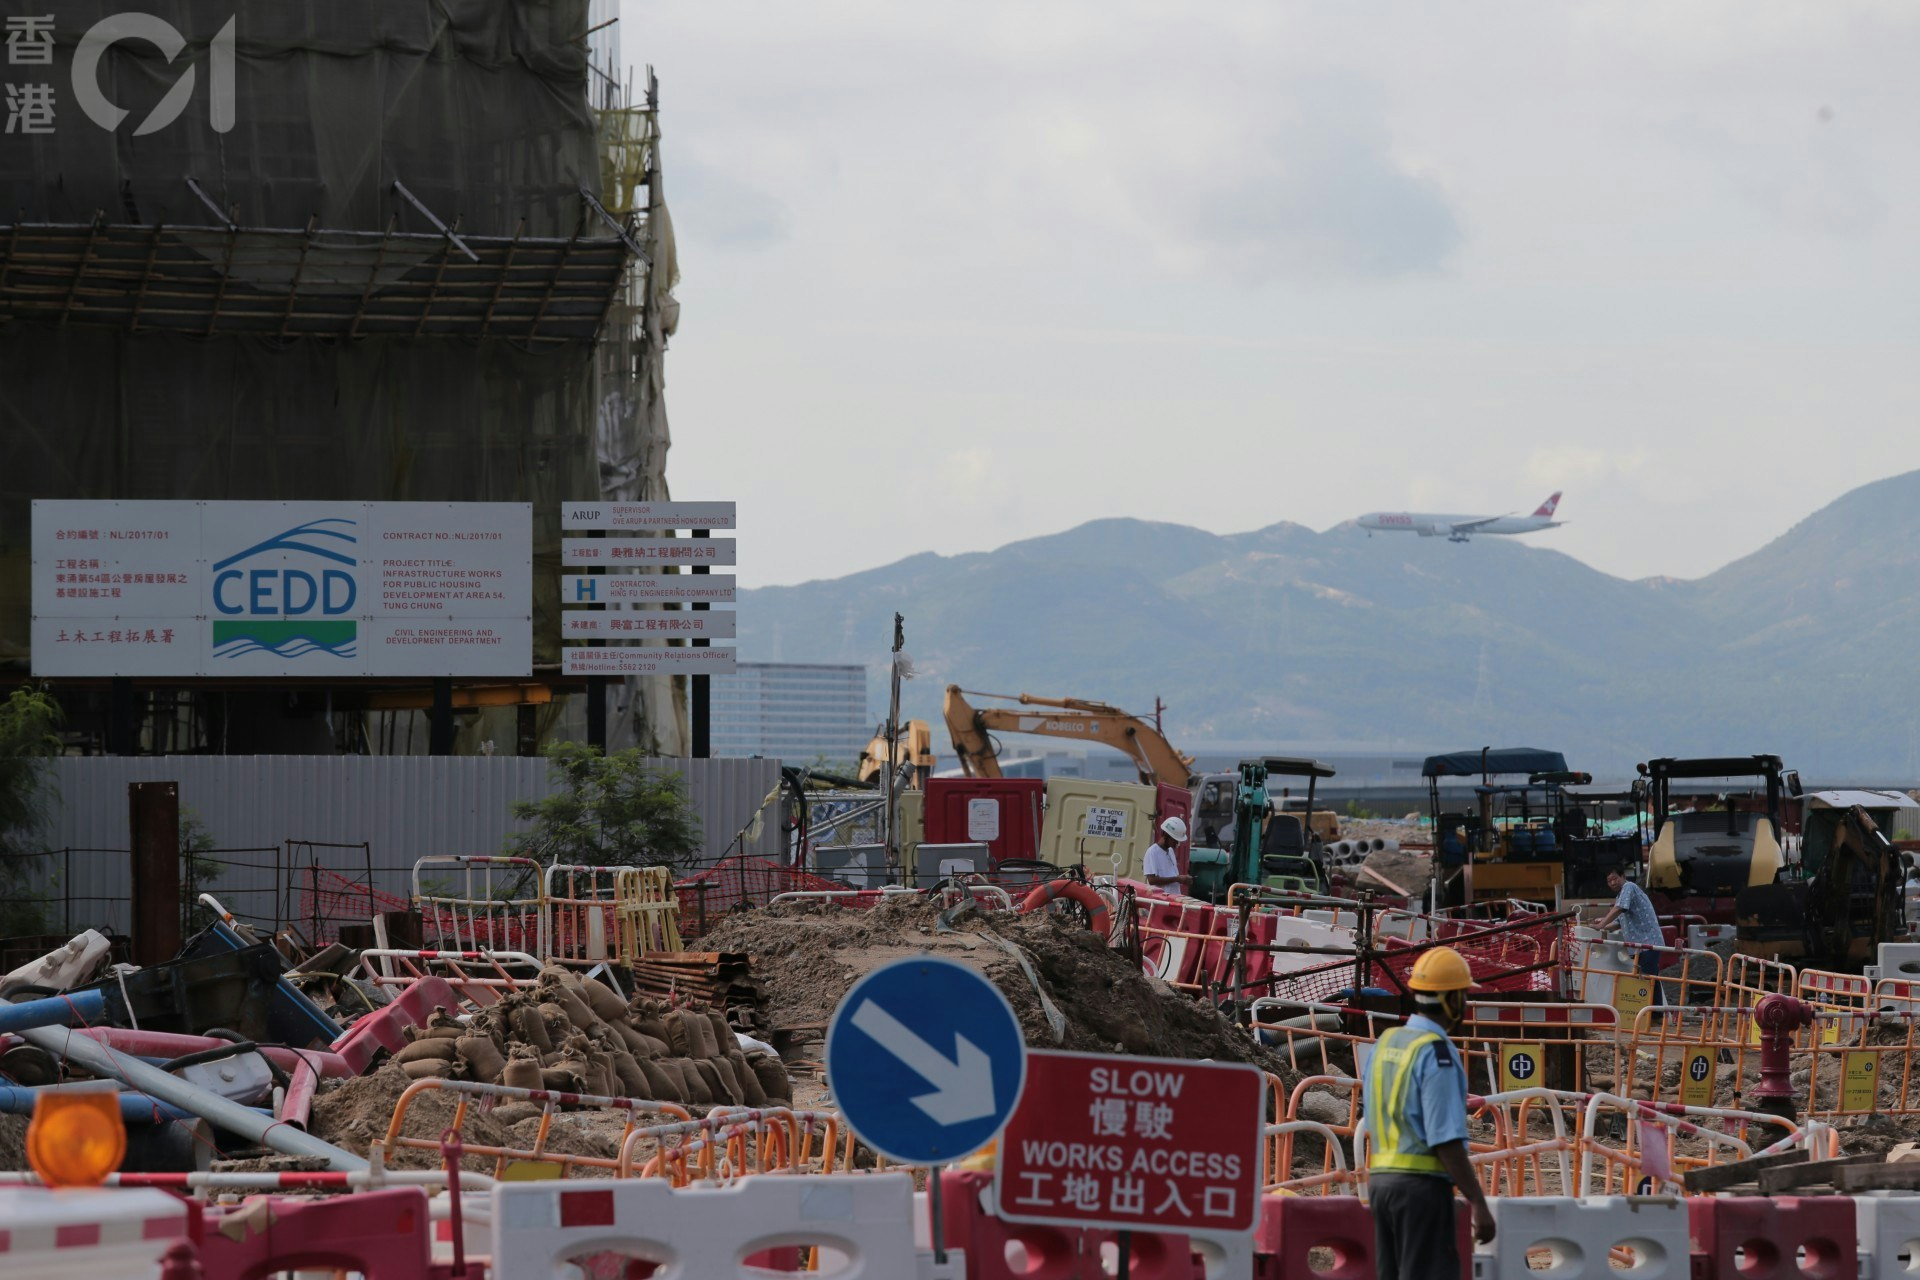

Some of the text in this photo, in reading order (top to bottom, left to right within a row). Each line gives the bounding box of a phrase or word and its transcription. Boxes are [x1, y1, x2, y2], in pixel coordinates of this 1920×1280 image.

[571, 511, 600, 520] ARUP
[612, 517, 625, 525] OVE
[625, 517, 642, 525] ARUP
[648, 517, 680, 525] PARTNERS
[681, 517, 698, 525] HONG
[699, 517, 716, 525] KONG
[717, 517, 729, 525] LTD
[1378, 515, 1412, 525] SWISS
[383, 532, 433, 540] CONTRACT
[383, 559, 425, 567] PROJECT
[383, 570, 502, 578] INFRASTRUCTURE WORKS
[383, 581, 481, 589] FOR PUBLIC HOUSING
[56, 587, 121, 598] 基礎設施工程
[213, 570, 356, 615] CEDD
[383, 591, 450, 599] DEVELOPMENT
[452, 591, 464, 599] AT
[465, 591, 491, 599] AREA
[610, 589, 732, 597] HING FU ENGINEERING COMPANY LTD
[383, 602, 443, 610] TUNG CHUNG
[610, 619, 704, 631] 興富工程有限公司
[56, 629, 175, 644] 土木工程拓展署
[394, 629, 493, 637] CIVIL ENGINEERING AND
[386, 637, 502, 645] DEVELOPMENT DEPARTMENT
[664, 651, 701, 659] Relations
[702, 651, 729, 659] Officer
[638, 663, 656, 671] 2120
[1046, 721, 1085, 732] KOBELCO
[1089, 1067, 1184, 1098] SLOW
[1089, 1097, 1174, 1140] 慢駛
[1022, 1139, 1241, 1180] WORKS ACCESS
[1015, 1171, 1236, 1218] 工地出入口
